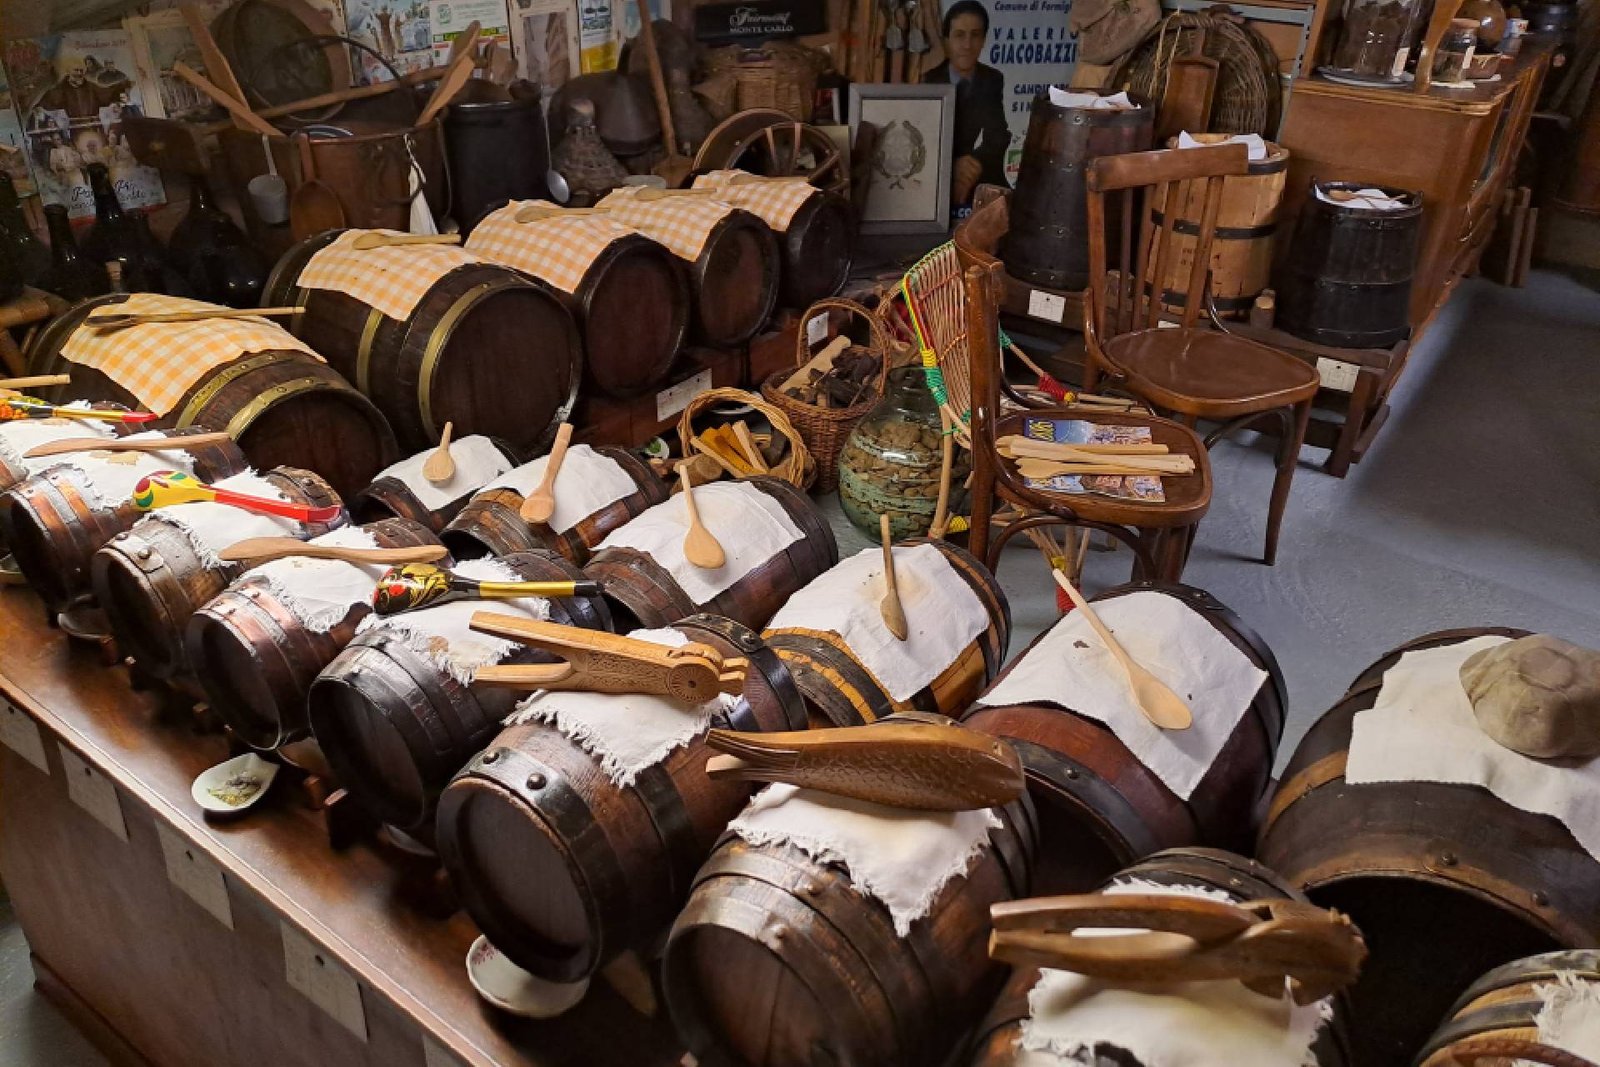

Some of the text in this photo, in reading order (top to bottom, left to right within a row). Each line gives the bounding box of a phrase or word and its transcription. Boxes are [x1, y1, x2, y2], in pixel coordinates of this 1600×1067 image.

[995, 1, 1028, 11] Comune
[1030, 0, 1039, 11] di
[990, 43, 1078, 64] GIACOBAZZI
